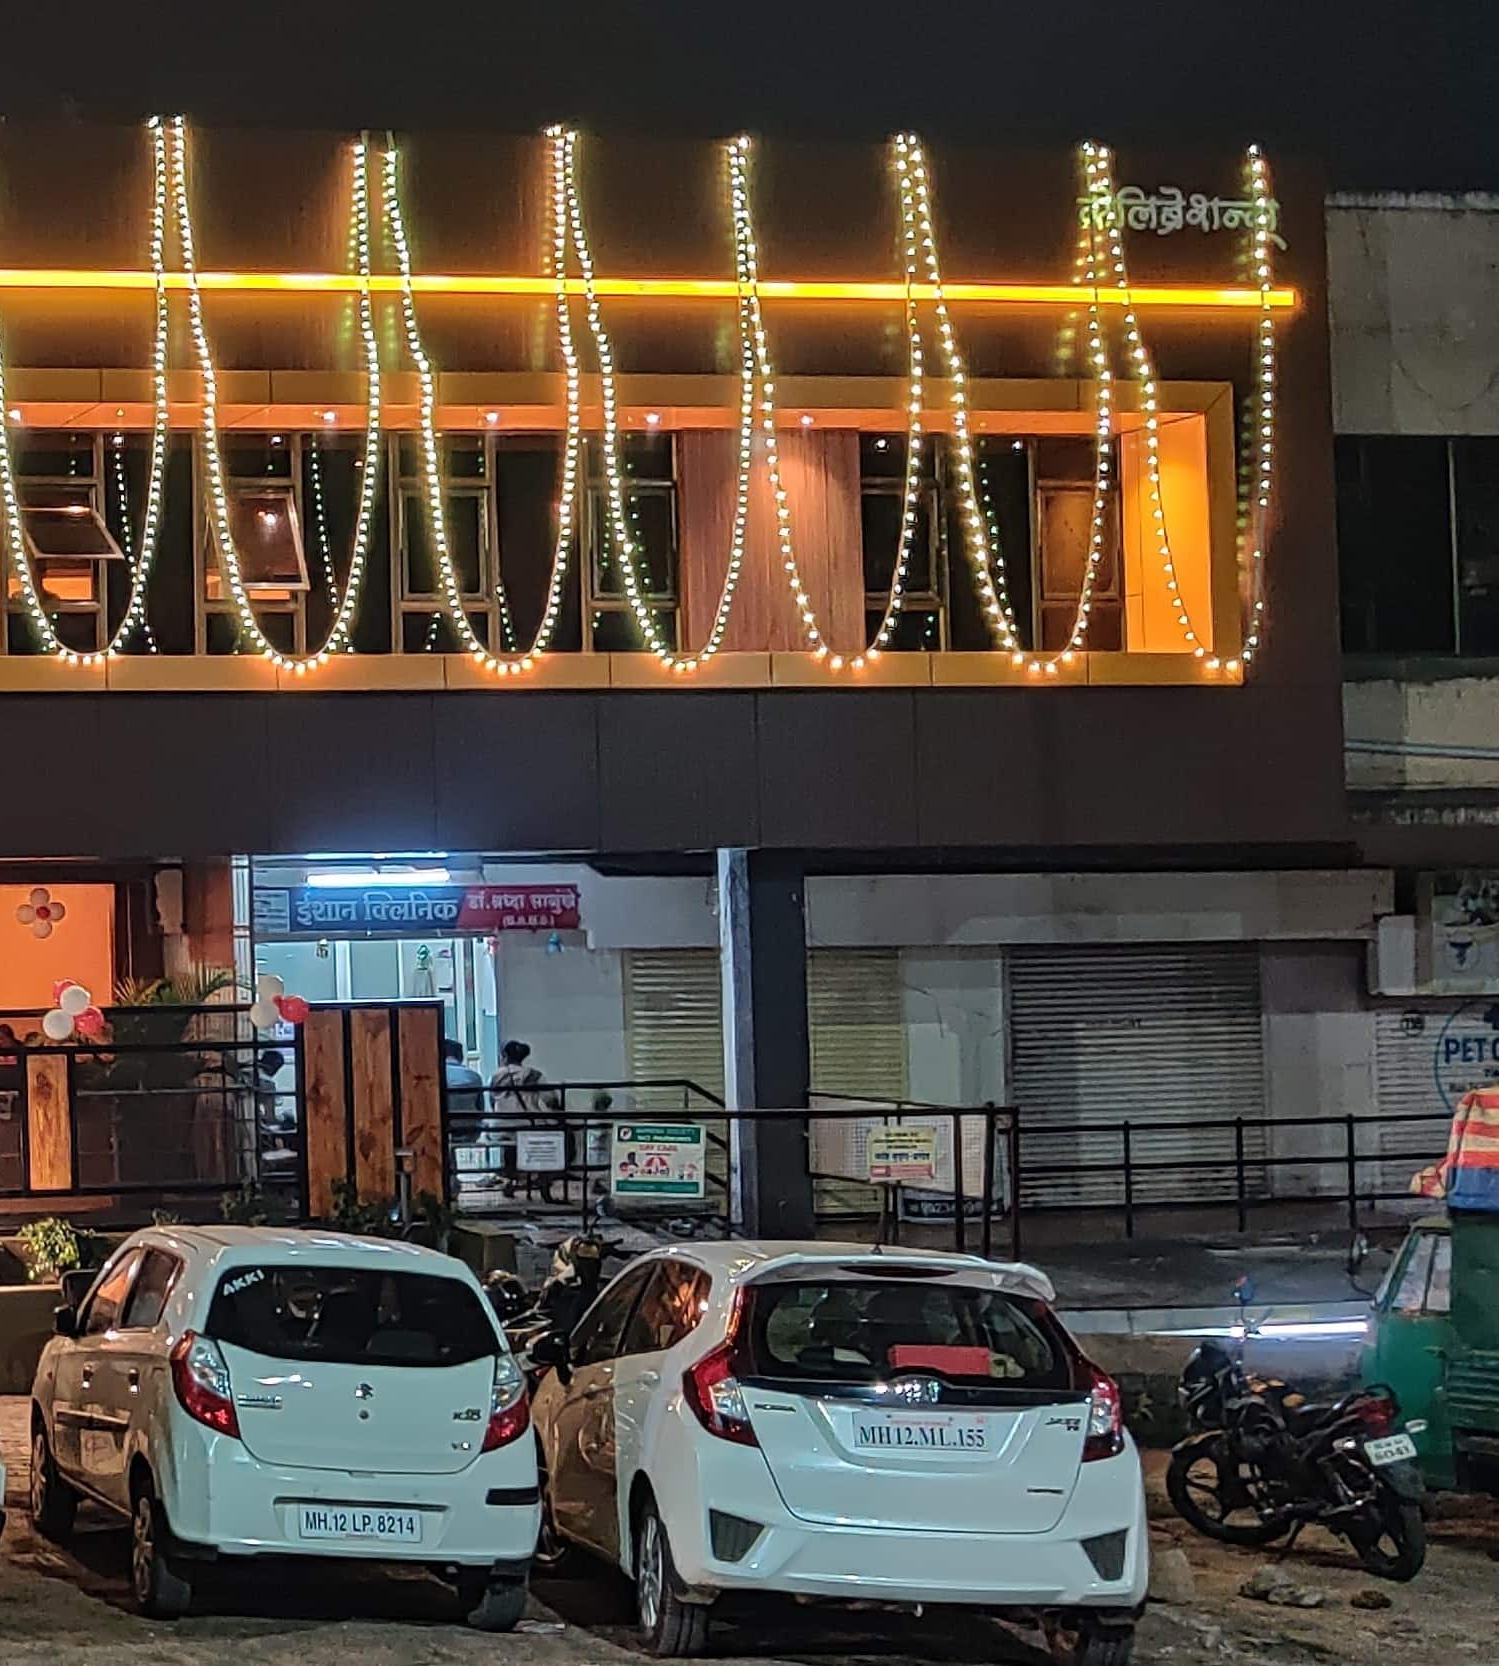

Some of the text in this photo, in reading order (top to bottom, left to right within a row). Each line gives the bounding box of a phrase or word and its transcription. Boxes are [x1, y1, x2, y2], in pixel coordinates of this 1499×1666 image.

[296, 891, 358, 926] ईशान
[363, 890, 460, 922] क्लिनिक
[1444, 1036, 1487, 1065] PET
[223, 1269, 265, 1297] AKKI
[377, 1515, 415, 1535] 8214
